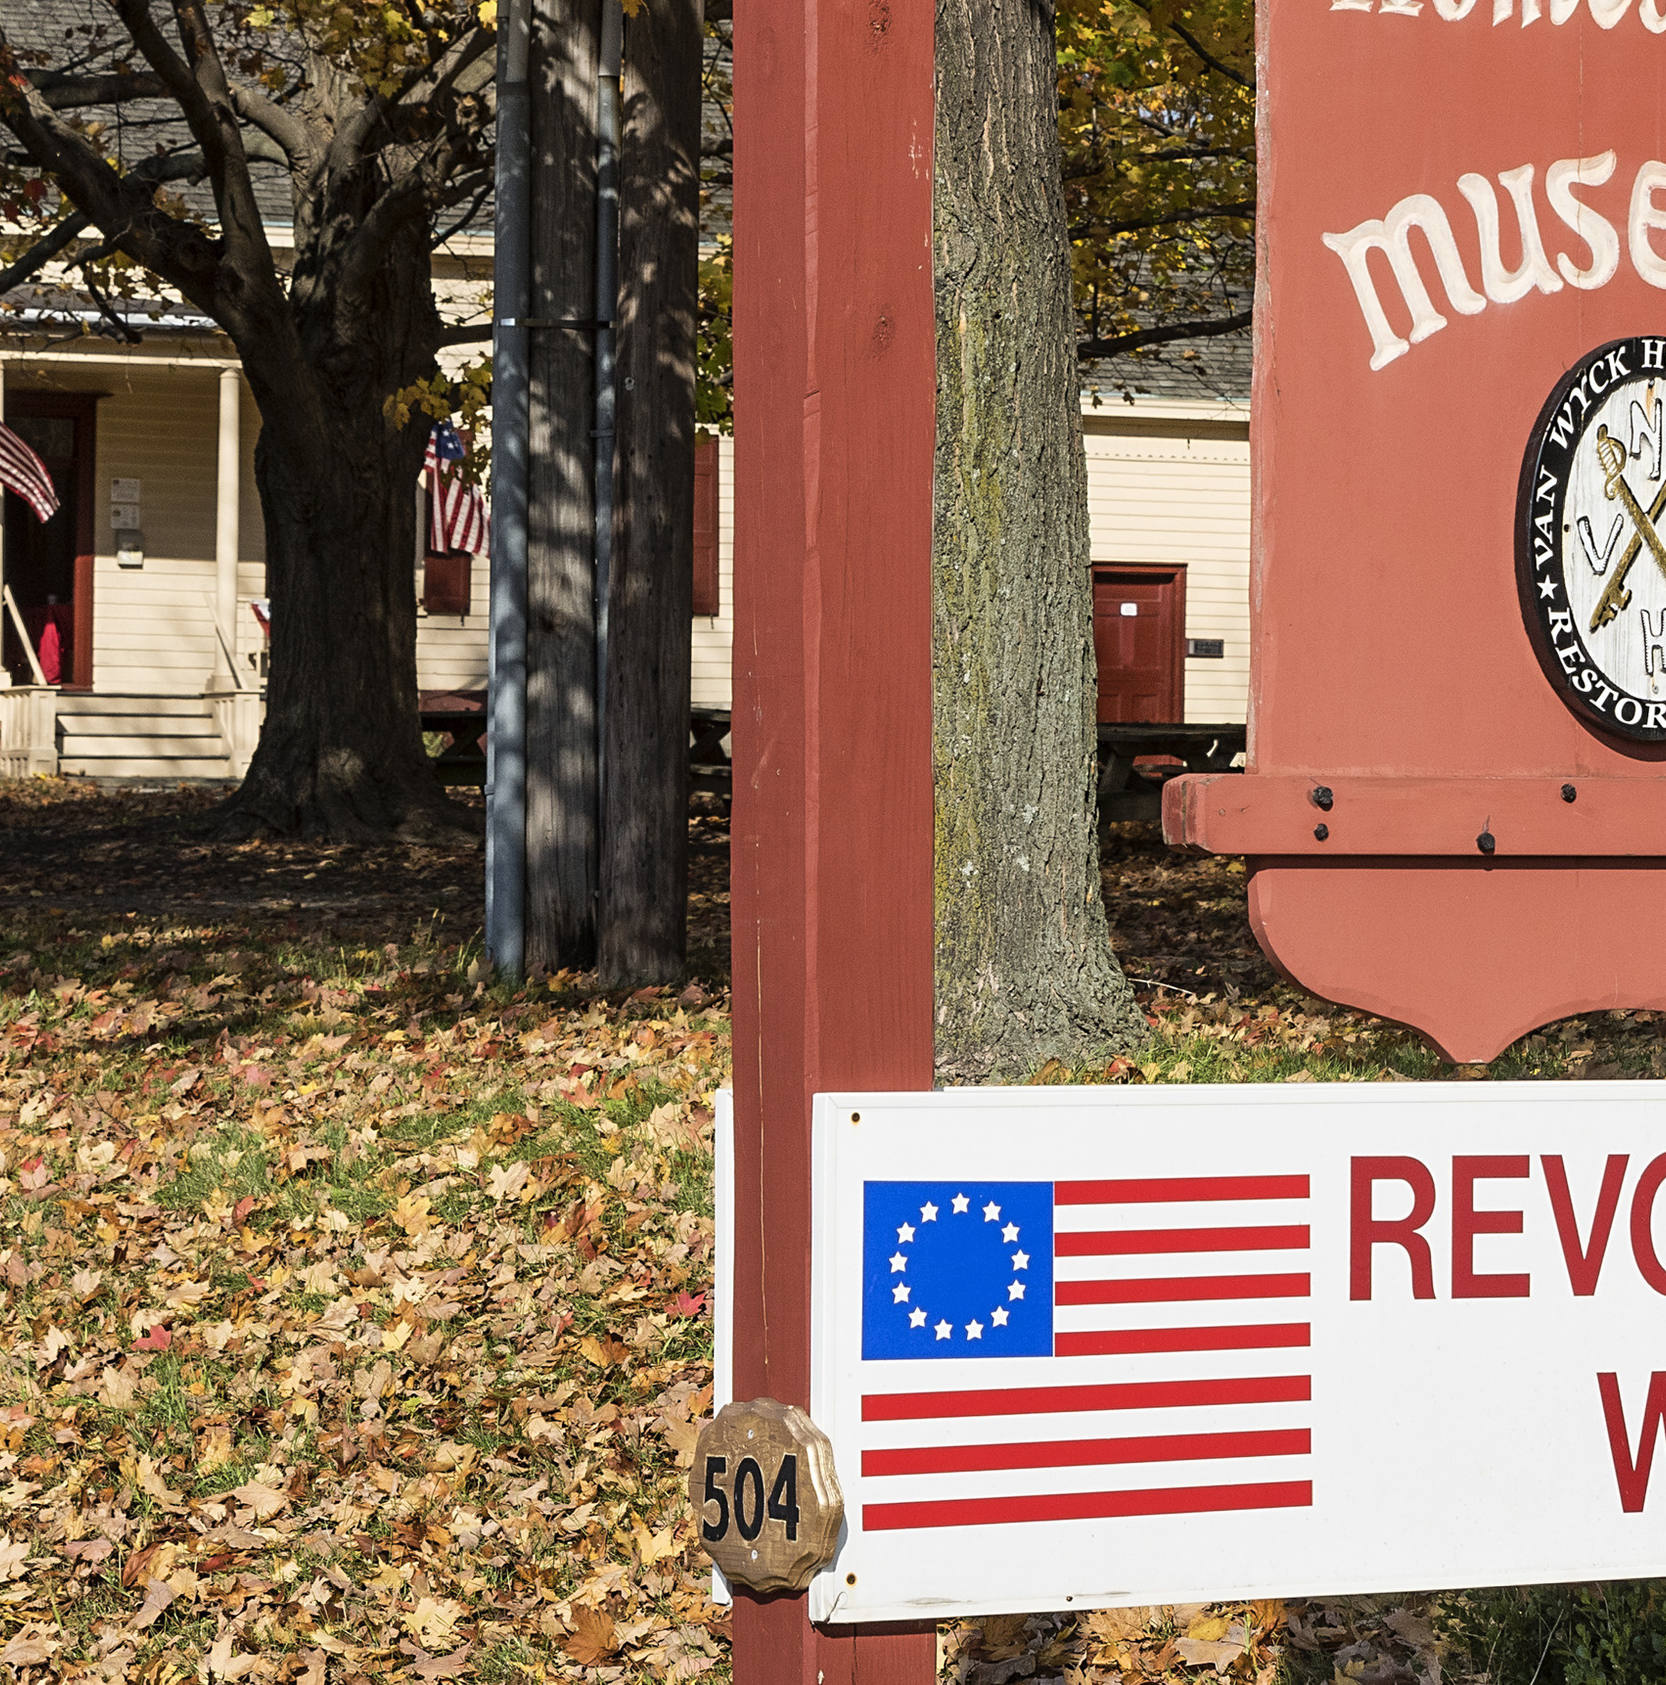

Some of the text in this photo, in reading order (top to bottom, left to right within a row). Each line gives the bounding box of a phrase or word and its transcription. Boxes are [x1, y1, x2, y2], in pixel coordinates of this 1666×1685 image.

[1533, 464, 1558, 571] VAN
[1548, 345, 1631, 451] WYCK
[1576, 514, 1625, 577] V
[701, 1453, 801, 1543] 504
